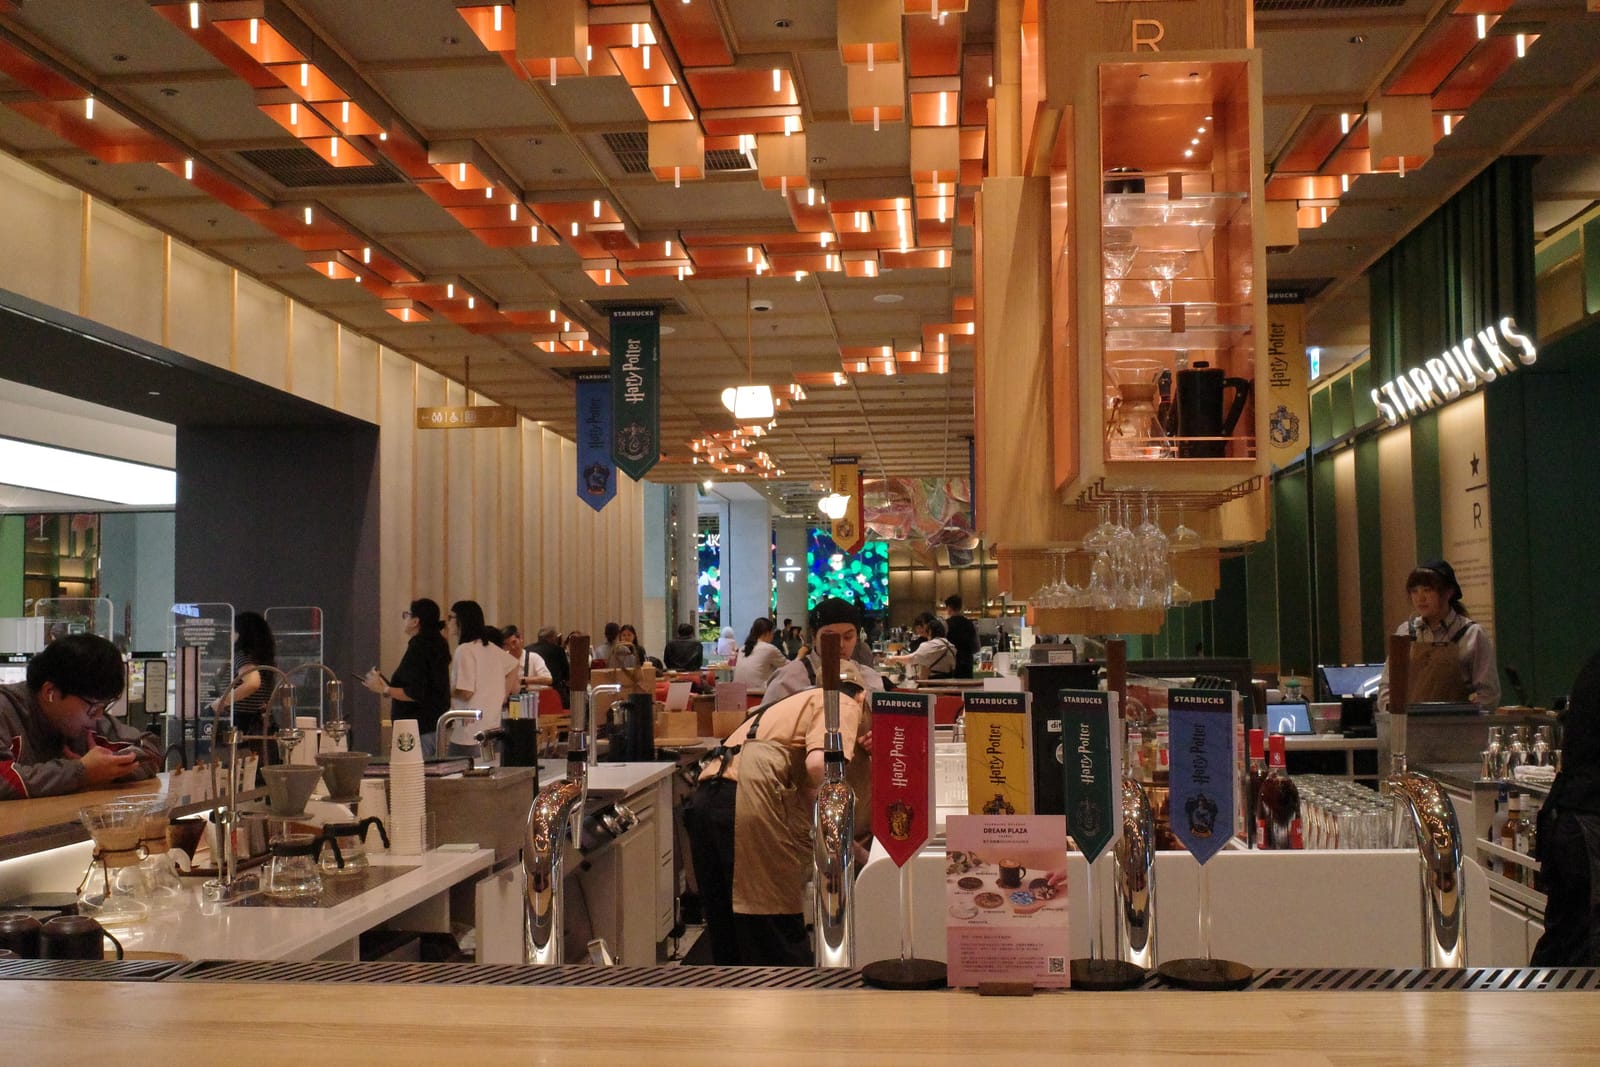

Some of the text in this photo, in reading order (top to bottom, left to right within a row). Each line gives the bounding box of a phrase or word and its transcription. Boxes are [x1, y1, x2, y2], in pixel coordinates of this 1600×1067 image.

[1132, 19, 1164, 52] R
[622, 338, 645, 404] Harry Potter
[1268, 322, 1291, 389] Harry Potter
[1370, 316, 1537, 426] STARBUCKS
[1472, 502, 1482, 529] R
[785, 572, 795, 583] R
[876, 700, 922, 709] STARBUCKS
[970, 697, 1018, 705] STARBUCKS
[1063, 696, 1103, 704] STARBUCKS
[1174, 696, 1225, 704] STARBUCKS
[890, 726, 908, 788] Harry Potter
[987, 724, 1007, 785] Harry Potter
[1078, 723, 1095, 785] Harry Potter
[1190, 722, 1210, 785] Harry Potter
